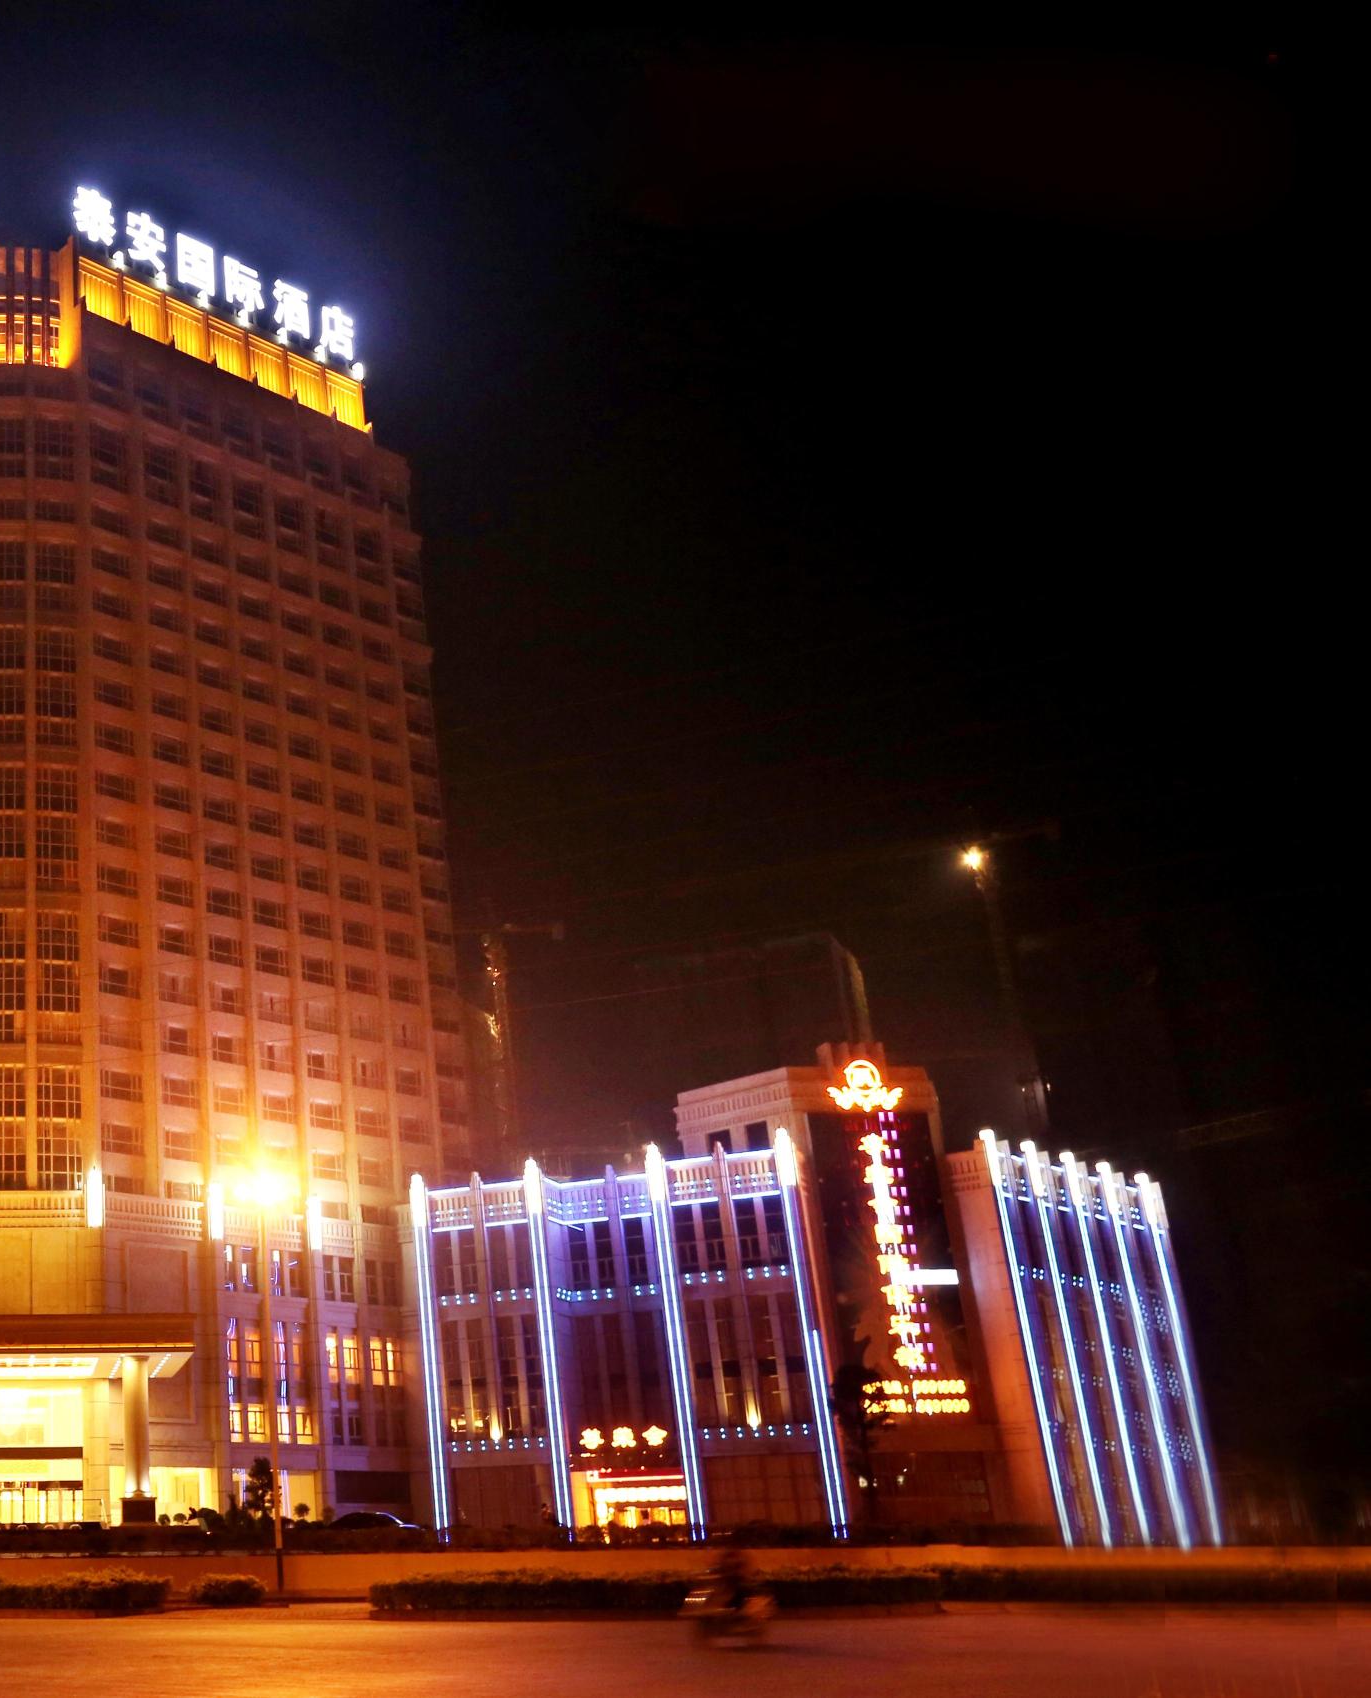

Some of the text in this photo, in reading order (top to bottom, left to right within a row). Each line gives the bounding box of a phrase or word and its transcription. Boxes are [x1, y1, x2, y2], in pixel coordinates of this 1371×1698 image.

[73, 187, 354, 361] 泰安国际酒店
